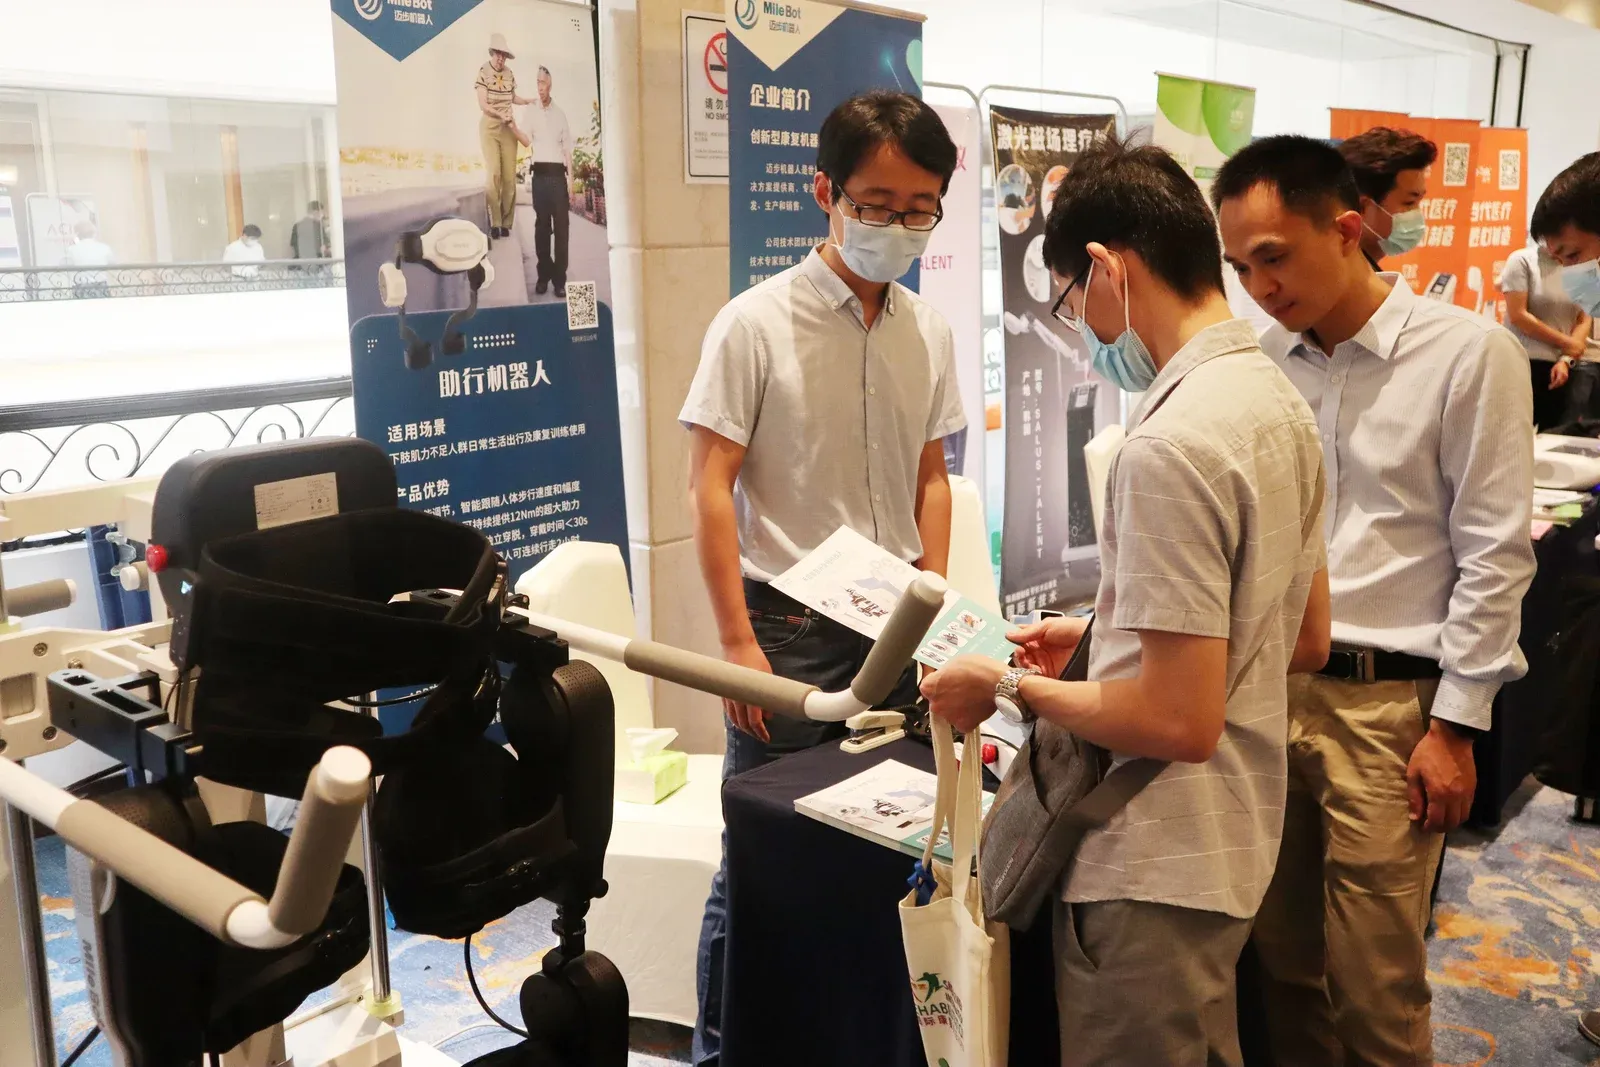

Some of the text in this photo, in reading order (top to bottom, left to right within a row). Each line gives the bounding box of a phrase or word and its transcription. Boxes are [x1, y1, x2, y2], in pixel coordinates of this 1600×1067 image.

[394, 9, 433, 26] 迈步机器人
[769, 19, 801, 35] 迈步机器人
[749, 83, 811, 111] 企业简介
[705, 112, 715, 120] NO
[438, 359, 552, 398] 助行机器人
[387, 418, 446, 443] 适用场景
[388, 423, 586, 466] 下肢肌力不足人群日常生活出行及康复训练使用
